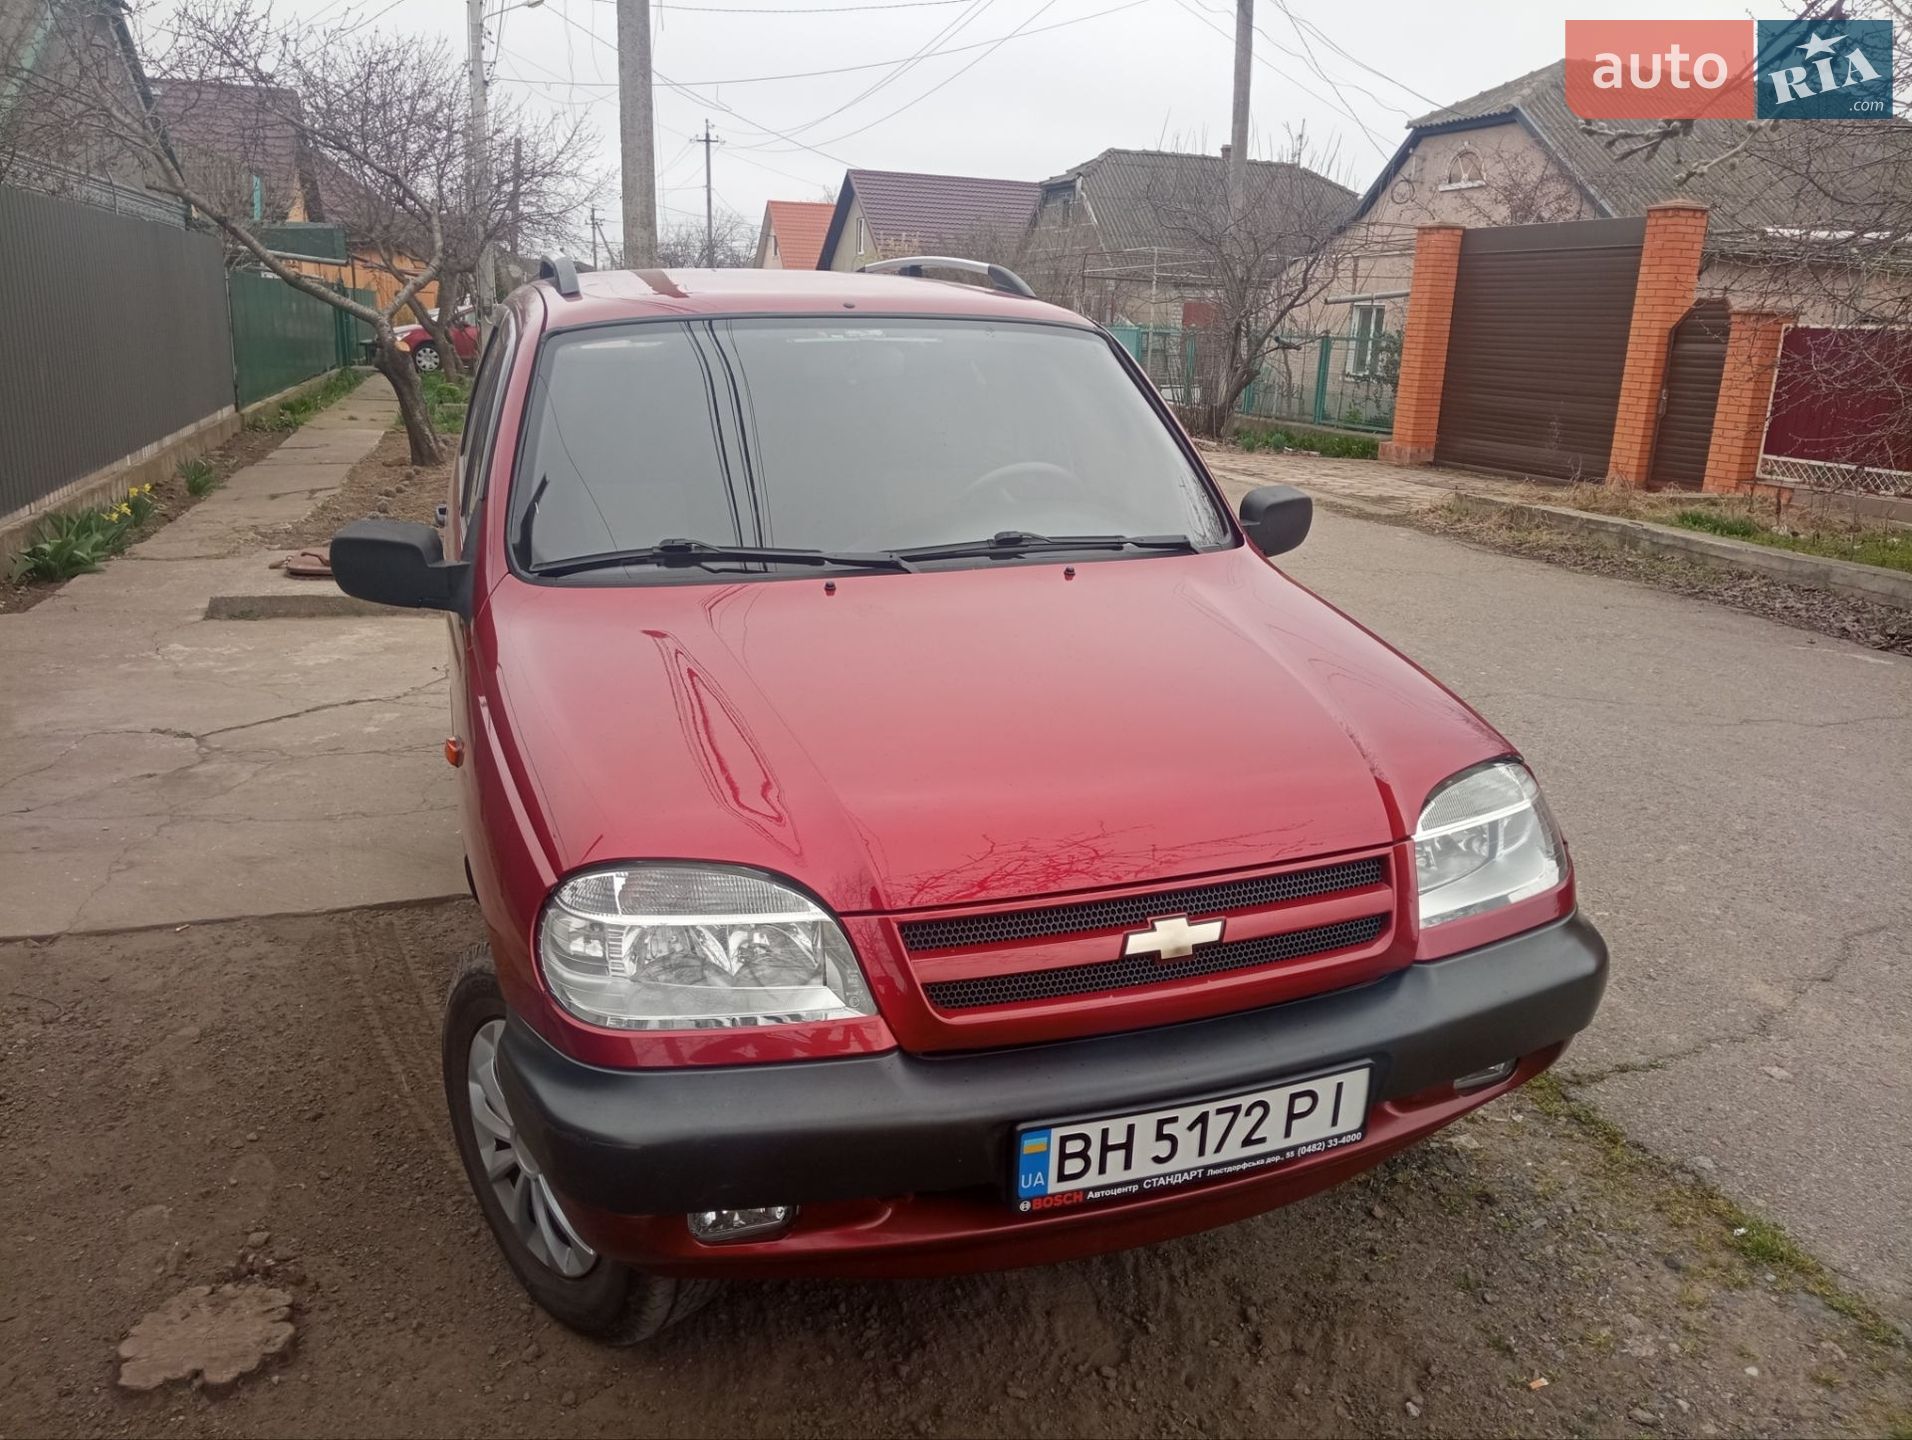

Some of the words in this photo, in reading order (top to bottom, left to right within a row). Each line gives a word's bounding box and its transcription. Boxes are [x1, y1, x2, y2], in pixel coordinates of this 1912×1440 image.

[1021, 1171, 1046, 1189] UA
[1032, 1191, 1084, 1210] BOSCH
[1086, 1184, 1139, 1200] Автоцентр
[1142, 1168, 1205, 1190] СТАНДАРТ
[1297, 1142, 1326, 1158] (0482)
[1327, 1131, 1362, 1149] 33-4000
[1057, 1123, 1136, 1183] BH
[1151, 1099, 1271, 1165] 5172
